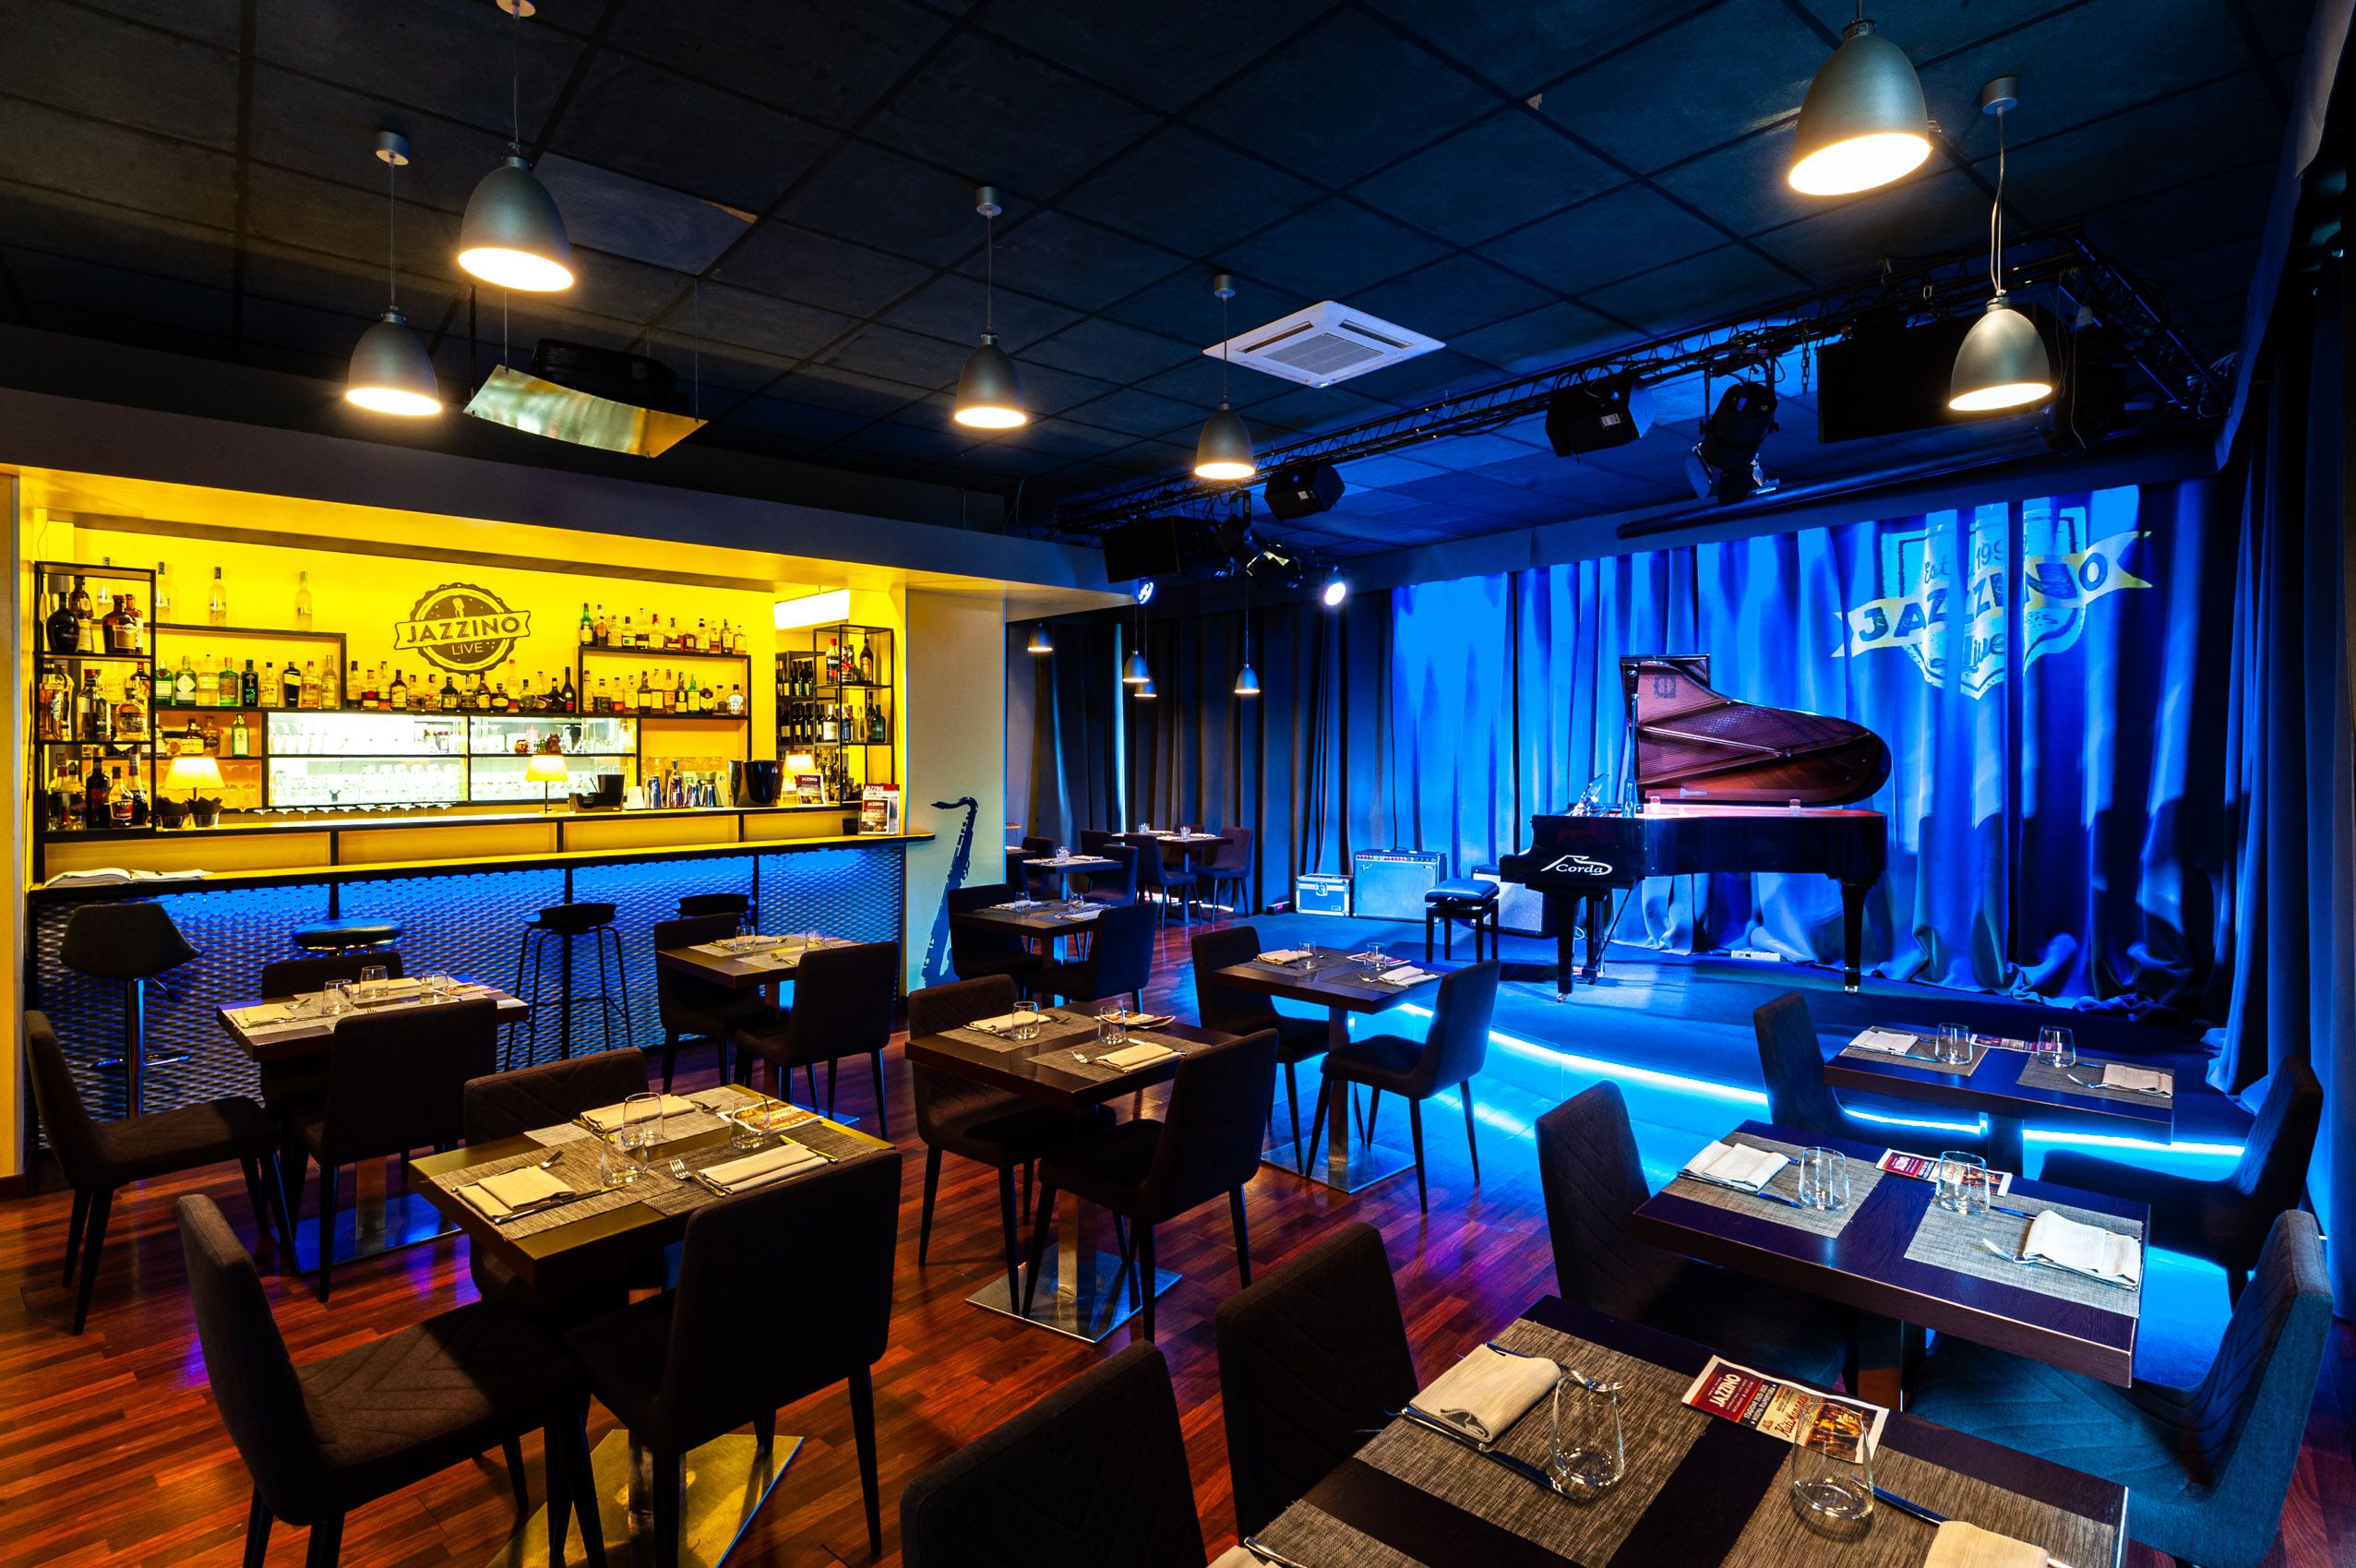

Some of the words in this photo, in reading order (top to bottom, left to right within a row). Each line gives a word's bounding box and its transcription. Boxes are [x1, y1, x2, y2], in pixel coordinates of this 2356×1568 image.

[407, 616, 520, 643] JAZZINO
[451, 642, 484, 655] LIVE
[1555, 863, 1604, 873] Corda
[1709, 1373, 1741, 1407] JAZZINO
